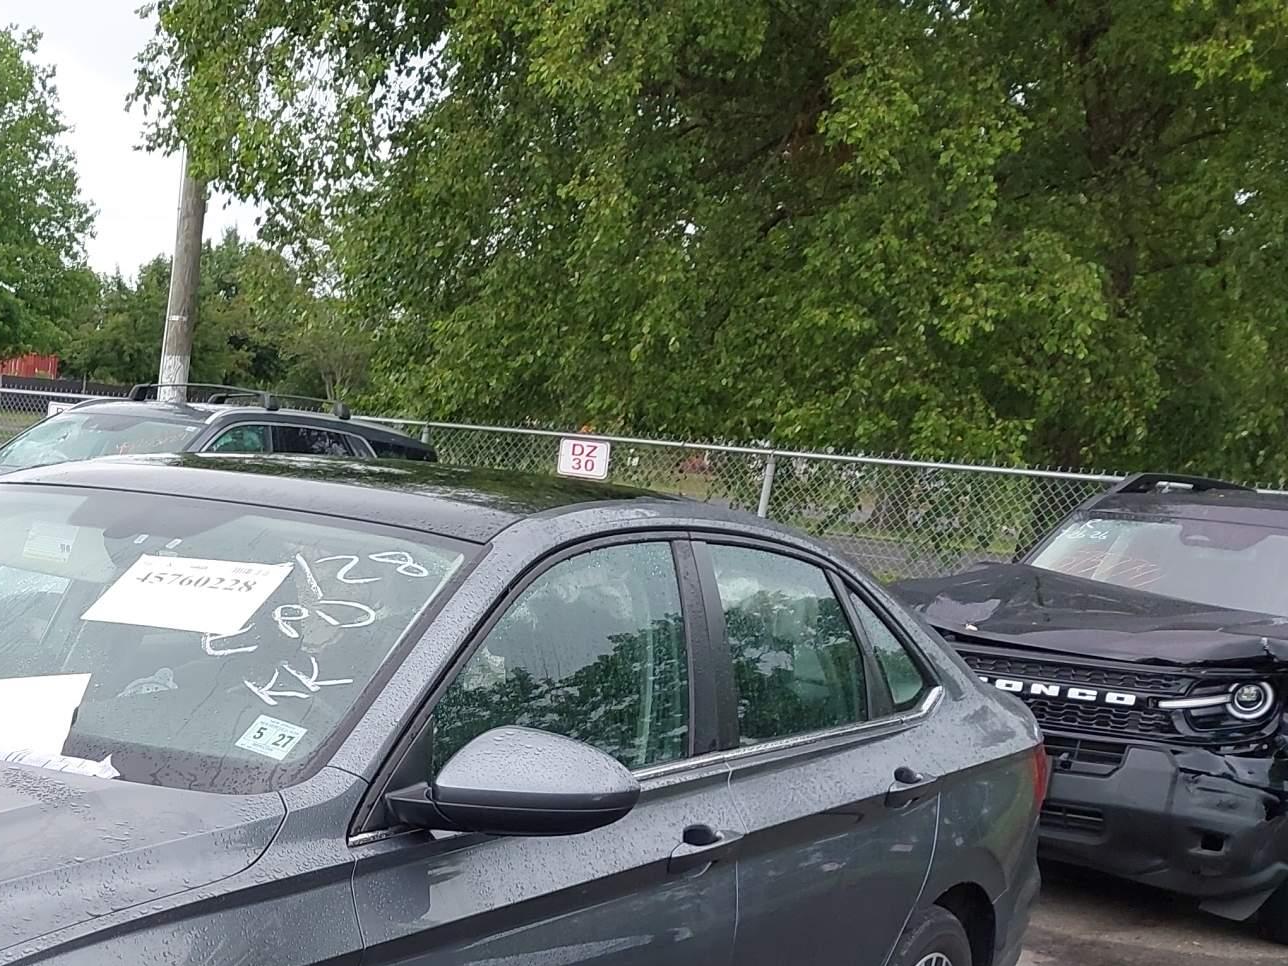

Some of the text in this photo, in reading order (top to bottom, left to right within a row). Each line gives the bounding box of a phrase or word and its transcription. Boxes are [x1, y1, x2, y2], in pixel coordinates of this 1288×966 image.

[571, 443, 598, 458] DZ
[571, 458, 595, 472] 30
[136, 570, 257, 593] 45760228
[978, 676, 1136, 706] ONCO
[253, 726, 267, 740] 5
[271, 733, 296, 748] 27
